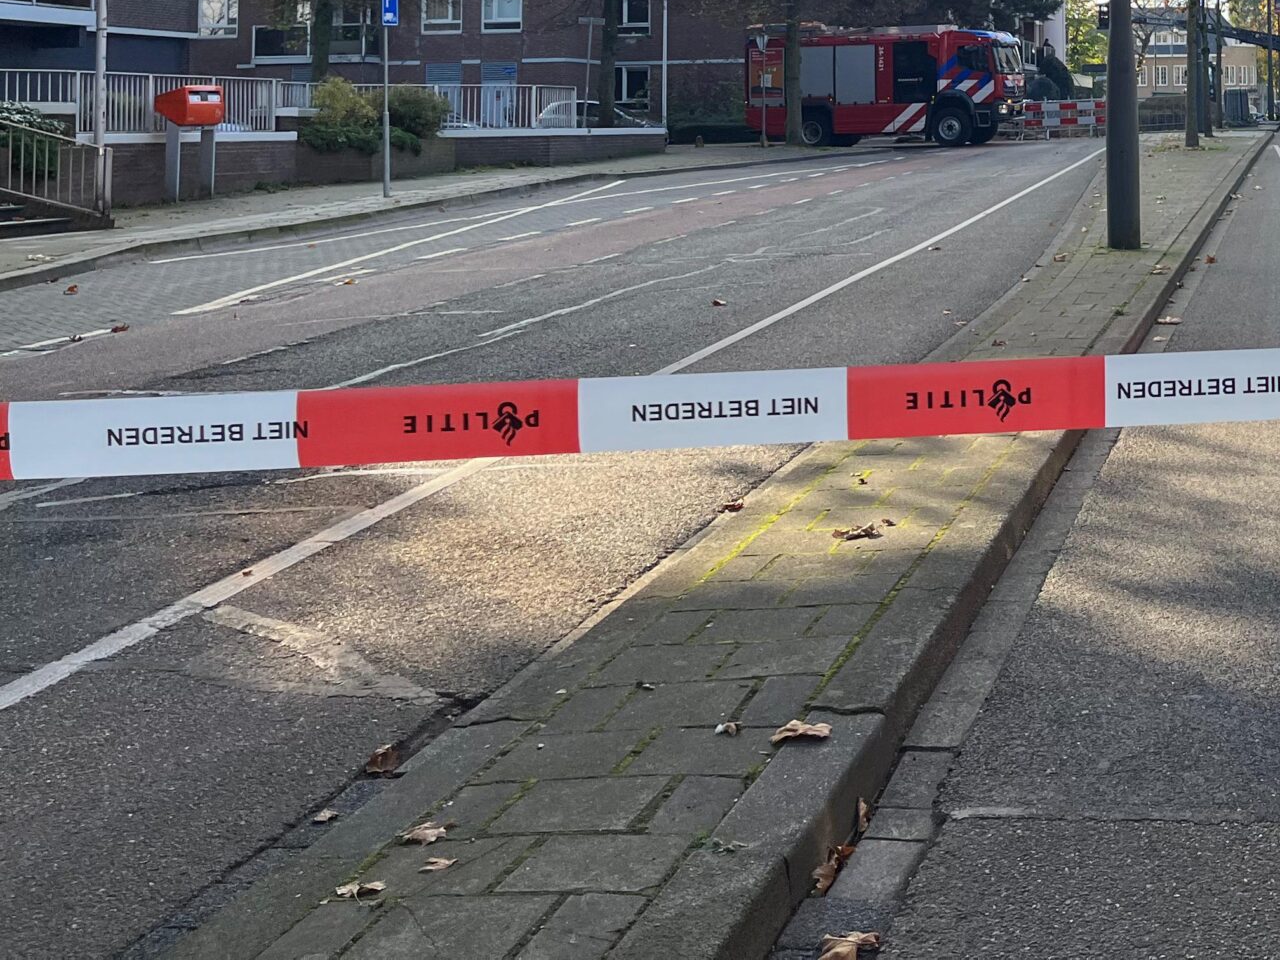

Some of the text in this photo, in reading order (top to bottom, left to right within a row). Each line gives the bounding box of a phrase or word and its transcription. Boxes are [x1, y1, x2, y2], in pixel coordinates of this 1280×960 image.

[1118, 378, 1235, 399] BETREDEN
[633, 397, 817, 421] NIET BETREDEN
[108, 421, 307, 445] NIET BETREDEN
